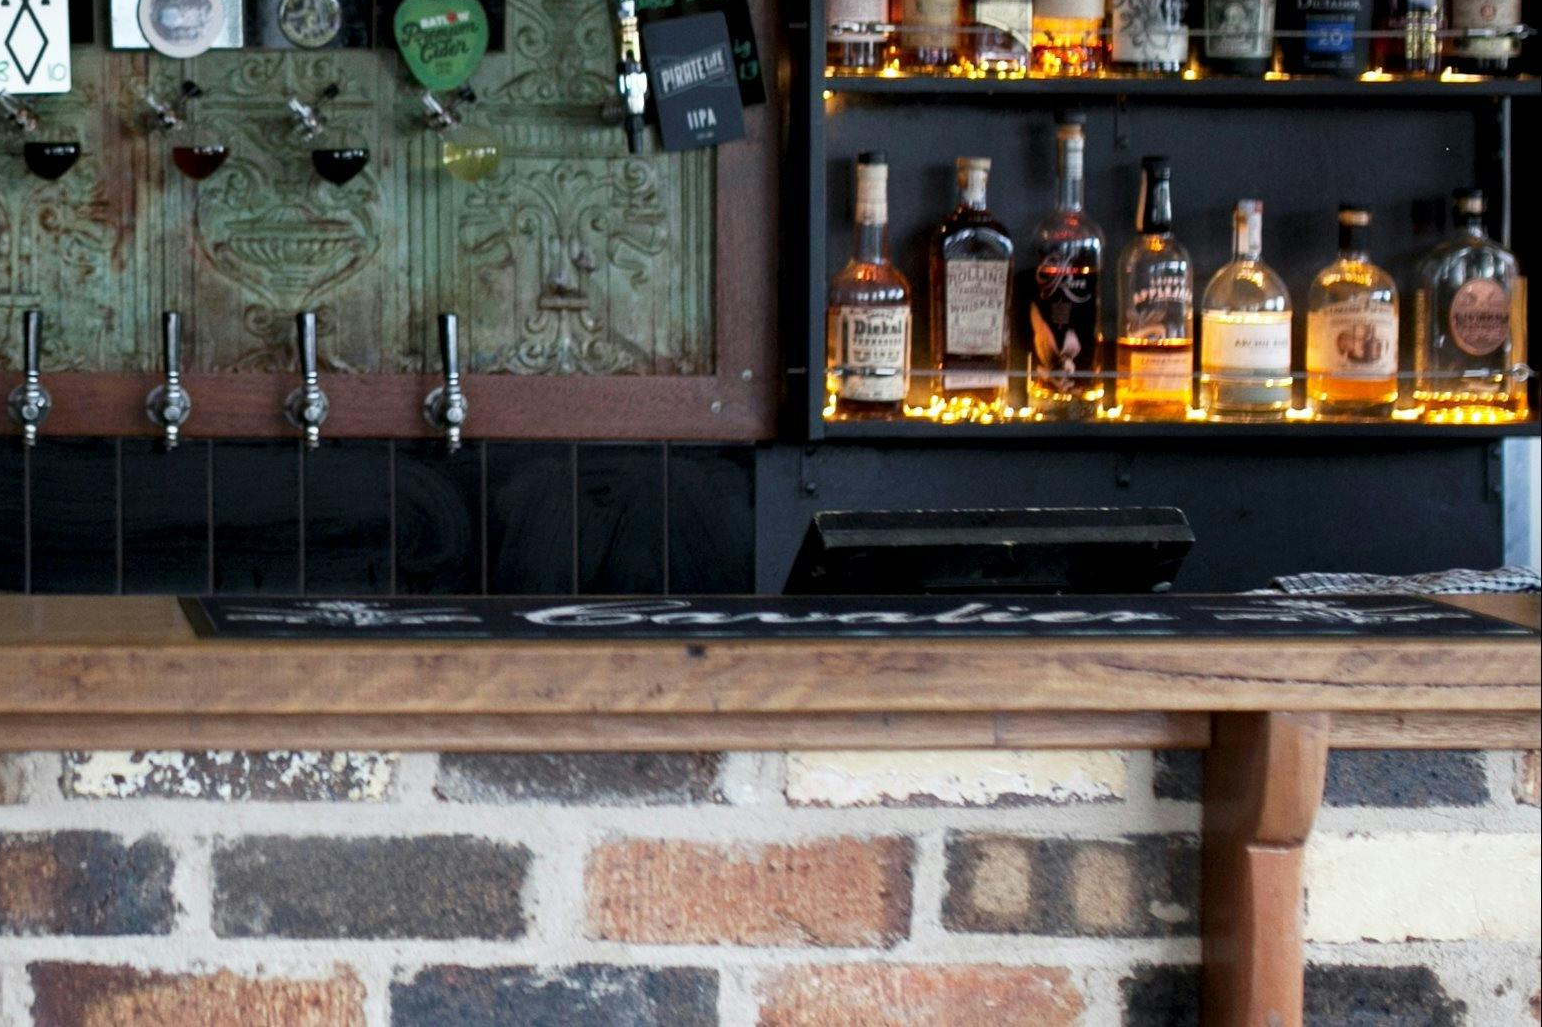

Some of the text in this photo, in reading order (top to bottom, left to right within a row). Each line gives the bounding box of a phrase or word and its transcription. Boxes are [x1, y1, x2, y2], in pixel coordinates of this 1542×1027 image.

[420, 10, 471, 29] BATLW
[661, 49, 725, 94] PIRATE LIFE
[687, 107, 717, 130] IIPA
